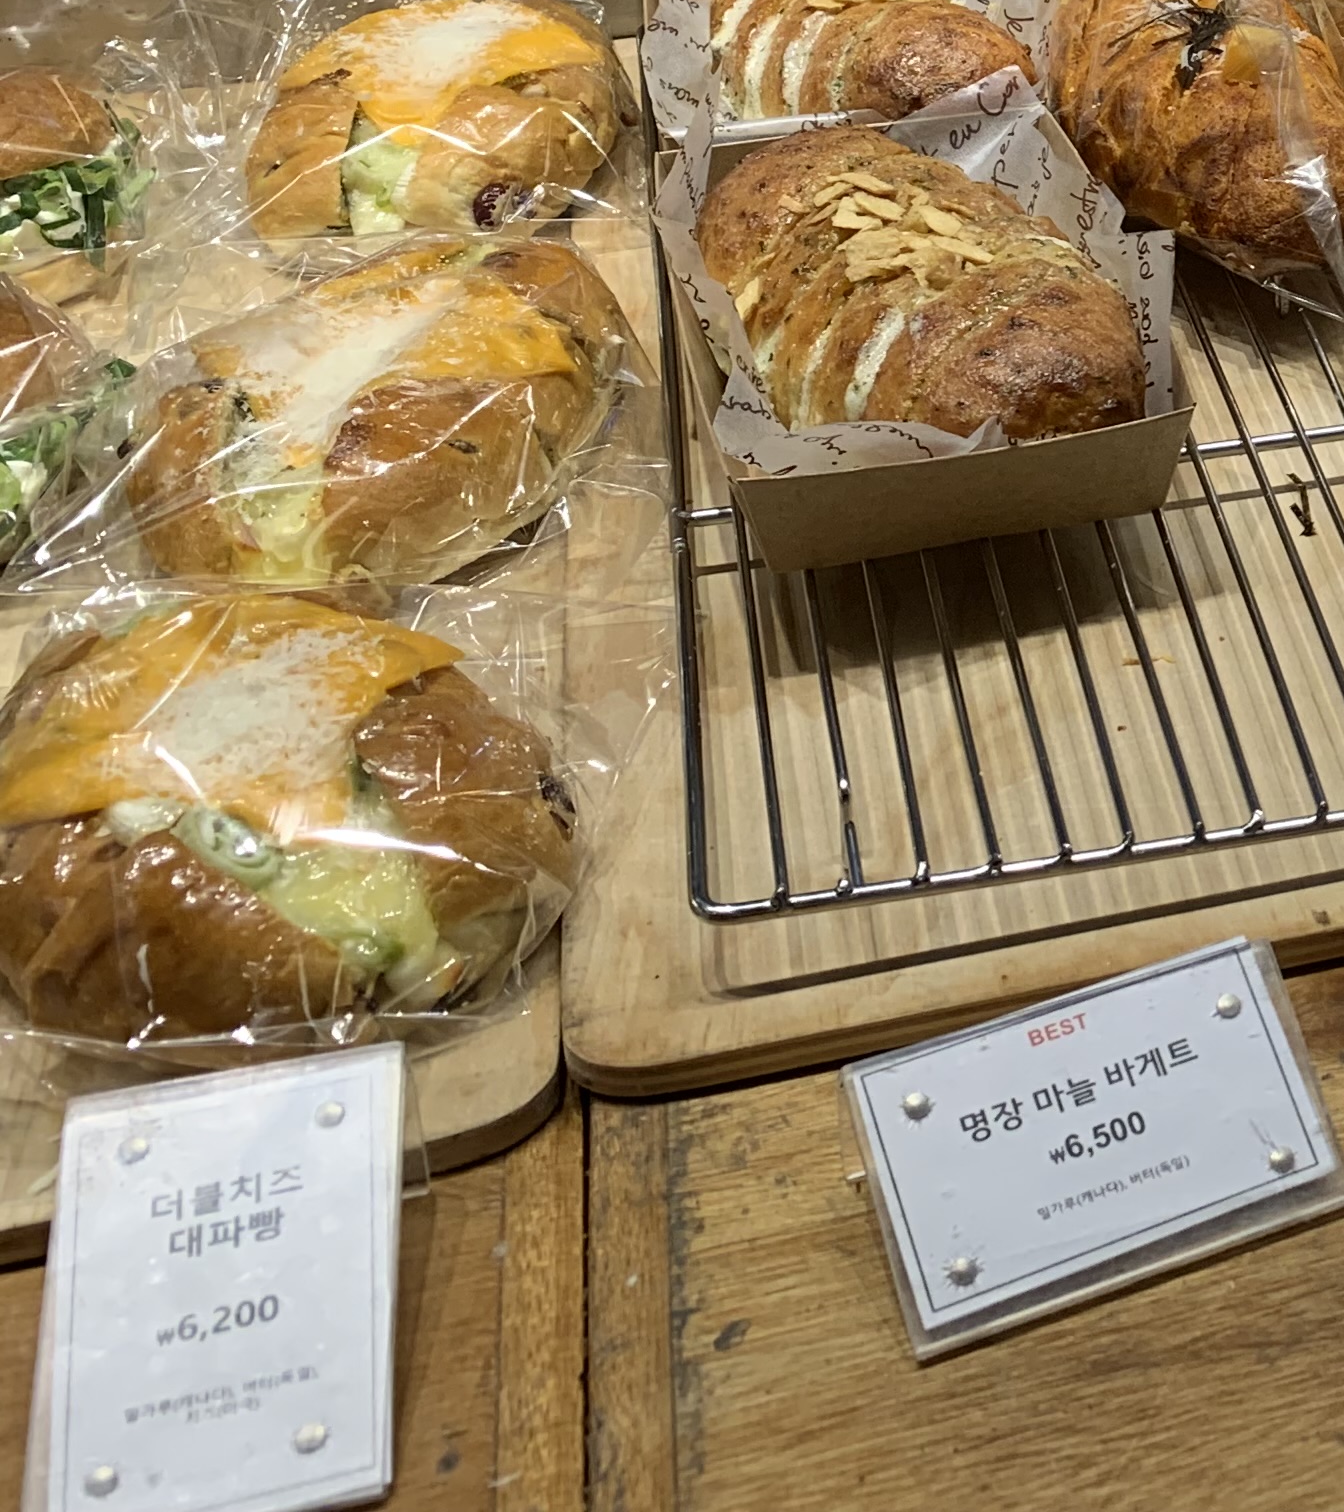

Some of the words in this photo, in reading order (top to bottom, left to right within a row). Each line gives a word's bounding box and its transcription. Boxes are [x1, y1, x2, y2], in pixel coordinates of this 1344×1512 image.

[1027, 1012, 1088, 1048] BEST
[959, 1099, 1025, 1144] 명장
[1033, 1074, 1096, 1117] 마늘
[1103, 1037, 1198, 1090] 바게트
[1048, 1110, 1147, 1166] ₩6,500
[151, 1164, 304, 1221] 더블치즈
[168, 1206, 285, 1258] 대파빵
[156, 1294, 281, 1347] ₩6,200
